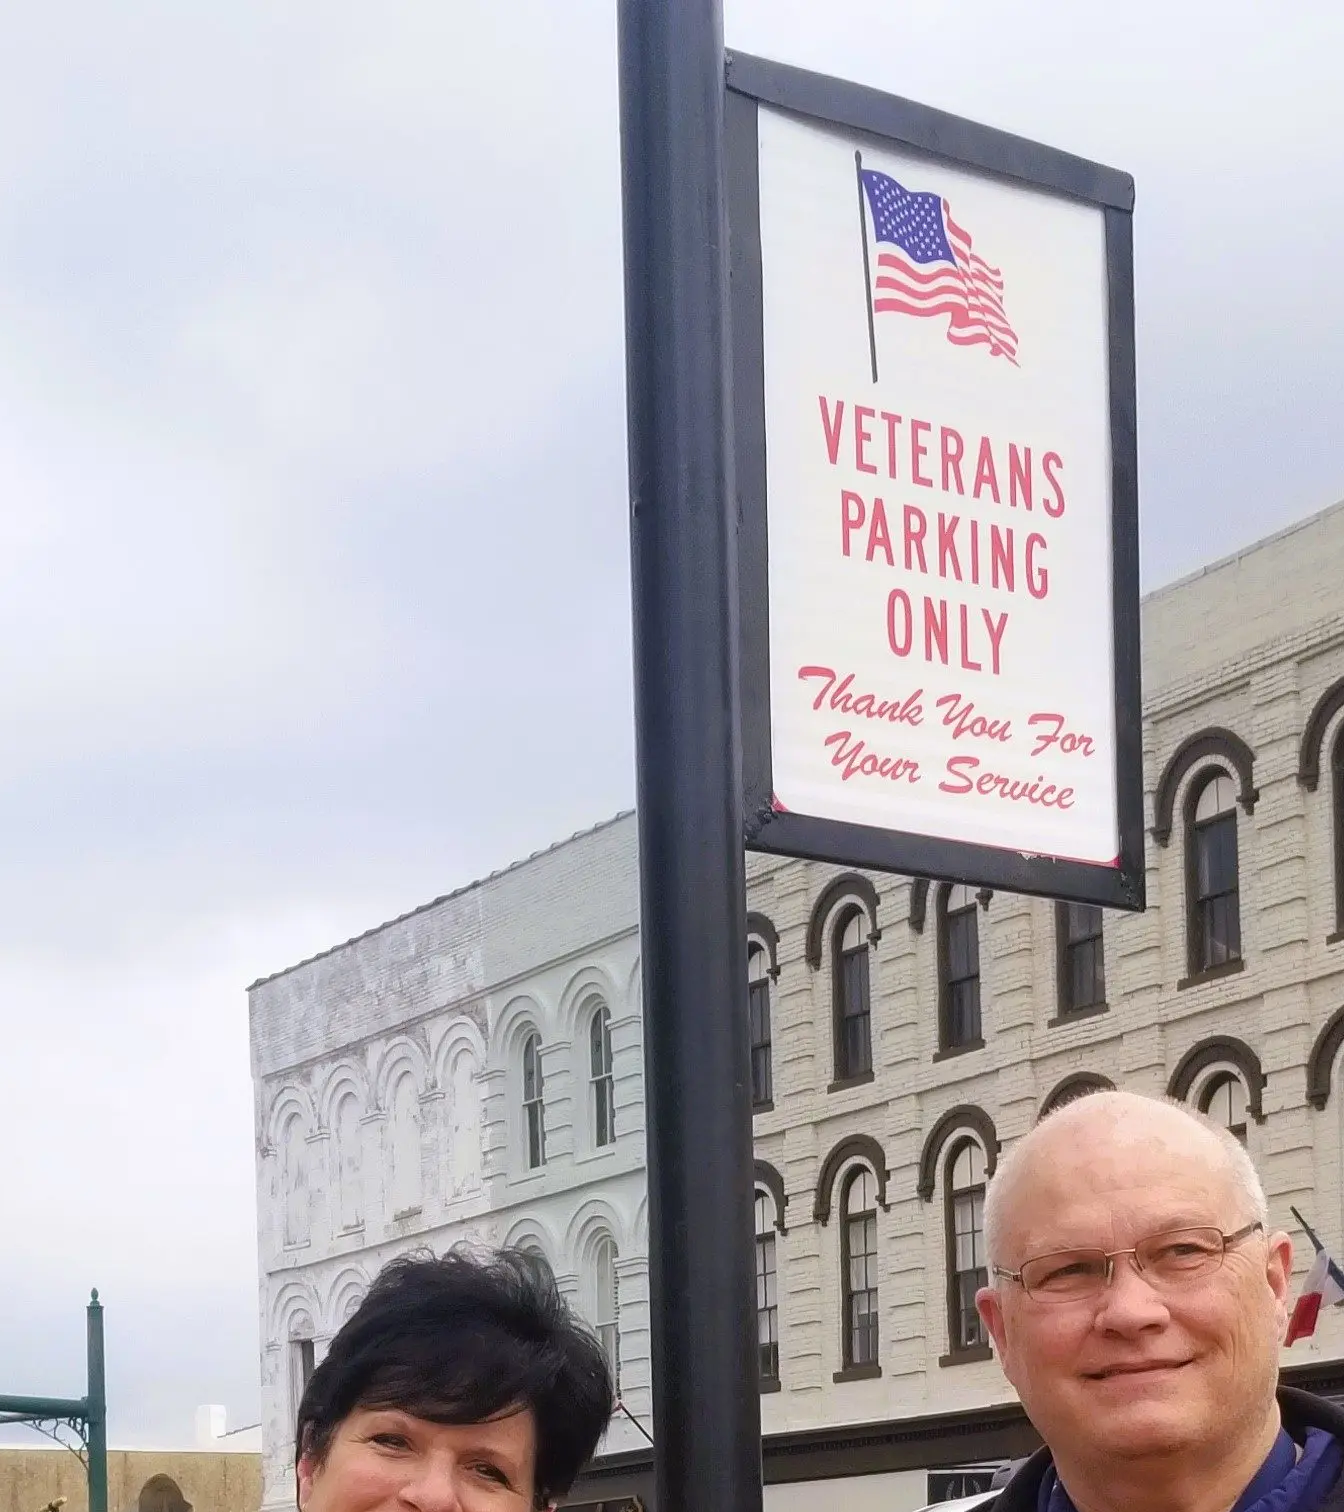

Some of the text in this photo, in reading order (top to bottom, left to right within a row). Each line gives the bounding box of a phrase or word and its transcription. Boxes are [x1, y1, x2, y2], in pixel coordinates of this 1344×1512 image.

[818, 395, 1065, 518] VETERANS
[841, 489, 1049, 600] PARKING
[886, 587, 1008, 675] ONLY
[797, 665, 1095, 758] Thank You For
[823, 731, 1076, 810] Your Service
